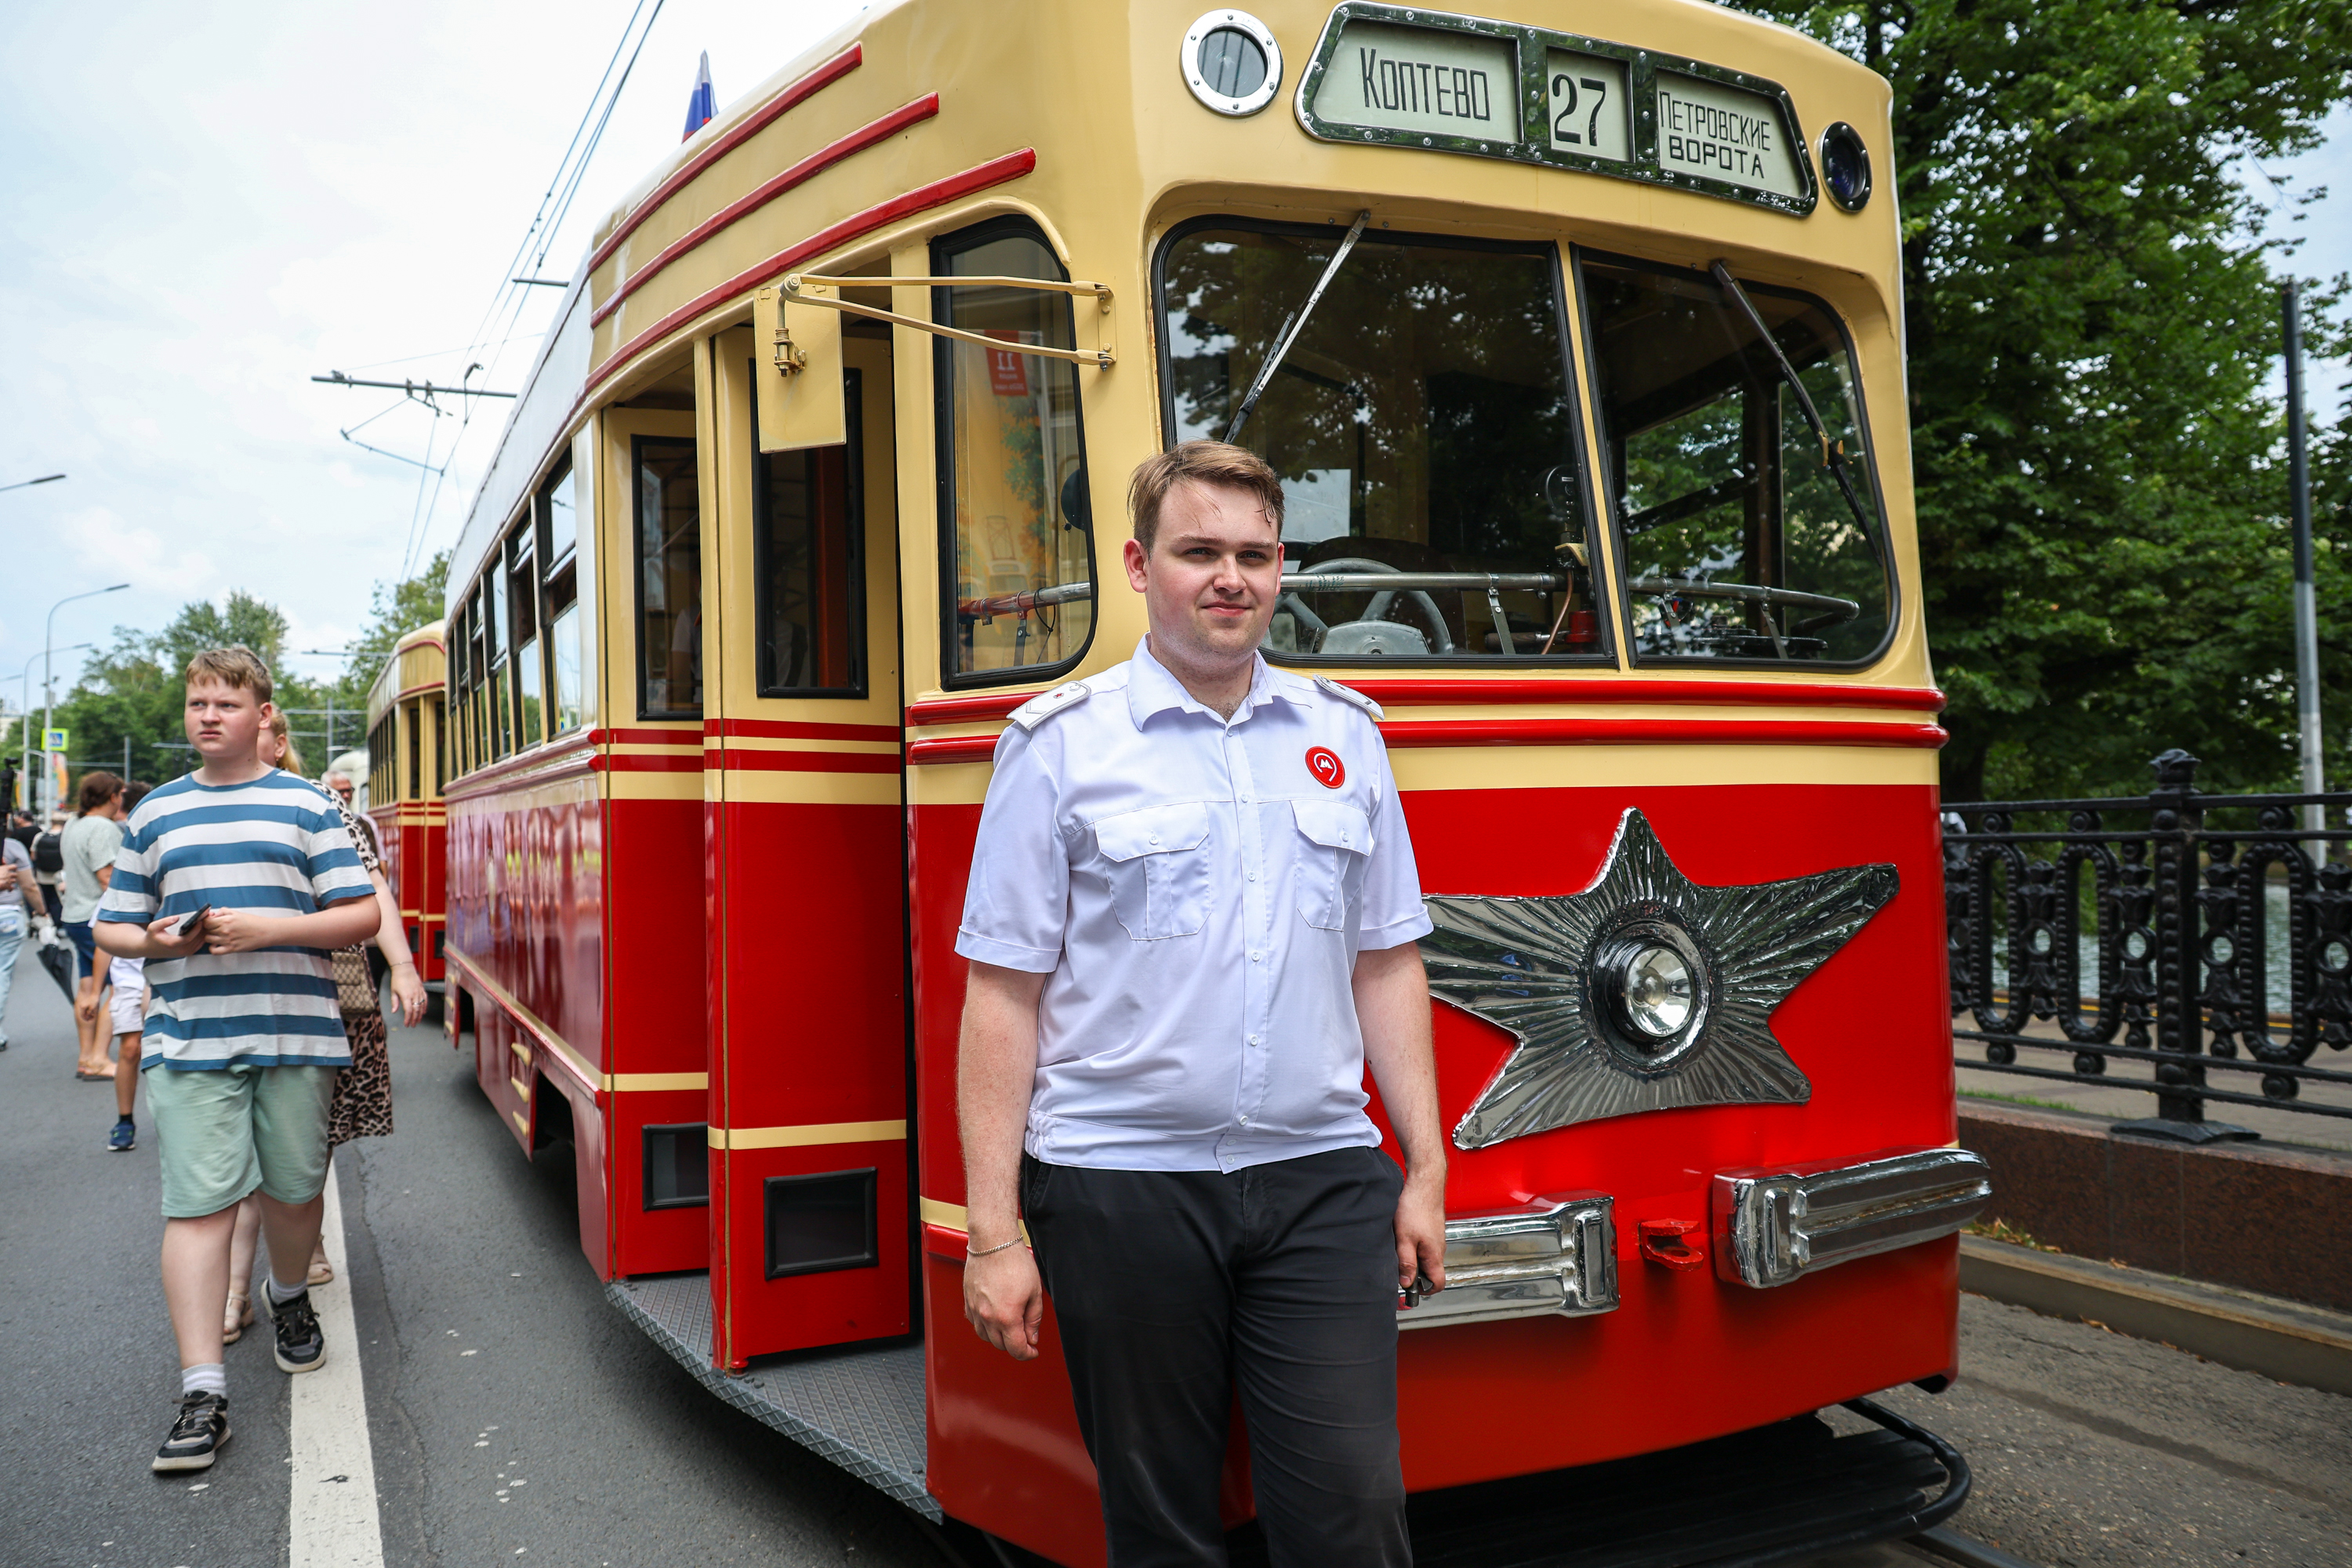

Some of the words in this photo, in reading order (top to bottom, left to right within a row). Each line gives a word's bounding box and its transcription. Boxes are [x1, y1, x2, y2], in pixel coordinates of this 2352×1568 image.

[1360, 47, 1490, 121] КОПТЕВО
[1552, 73, 1606, 147] 27
[1659, 91, 1770, 151] ПЕТРОВСКИЕ
[1669, 134, 1765, 179] ВОРОТА
